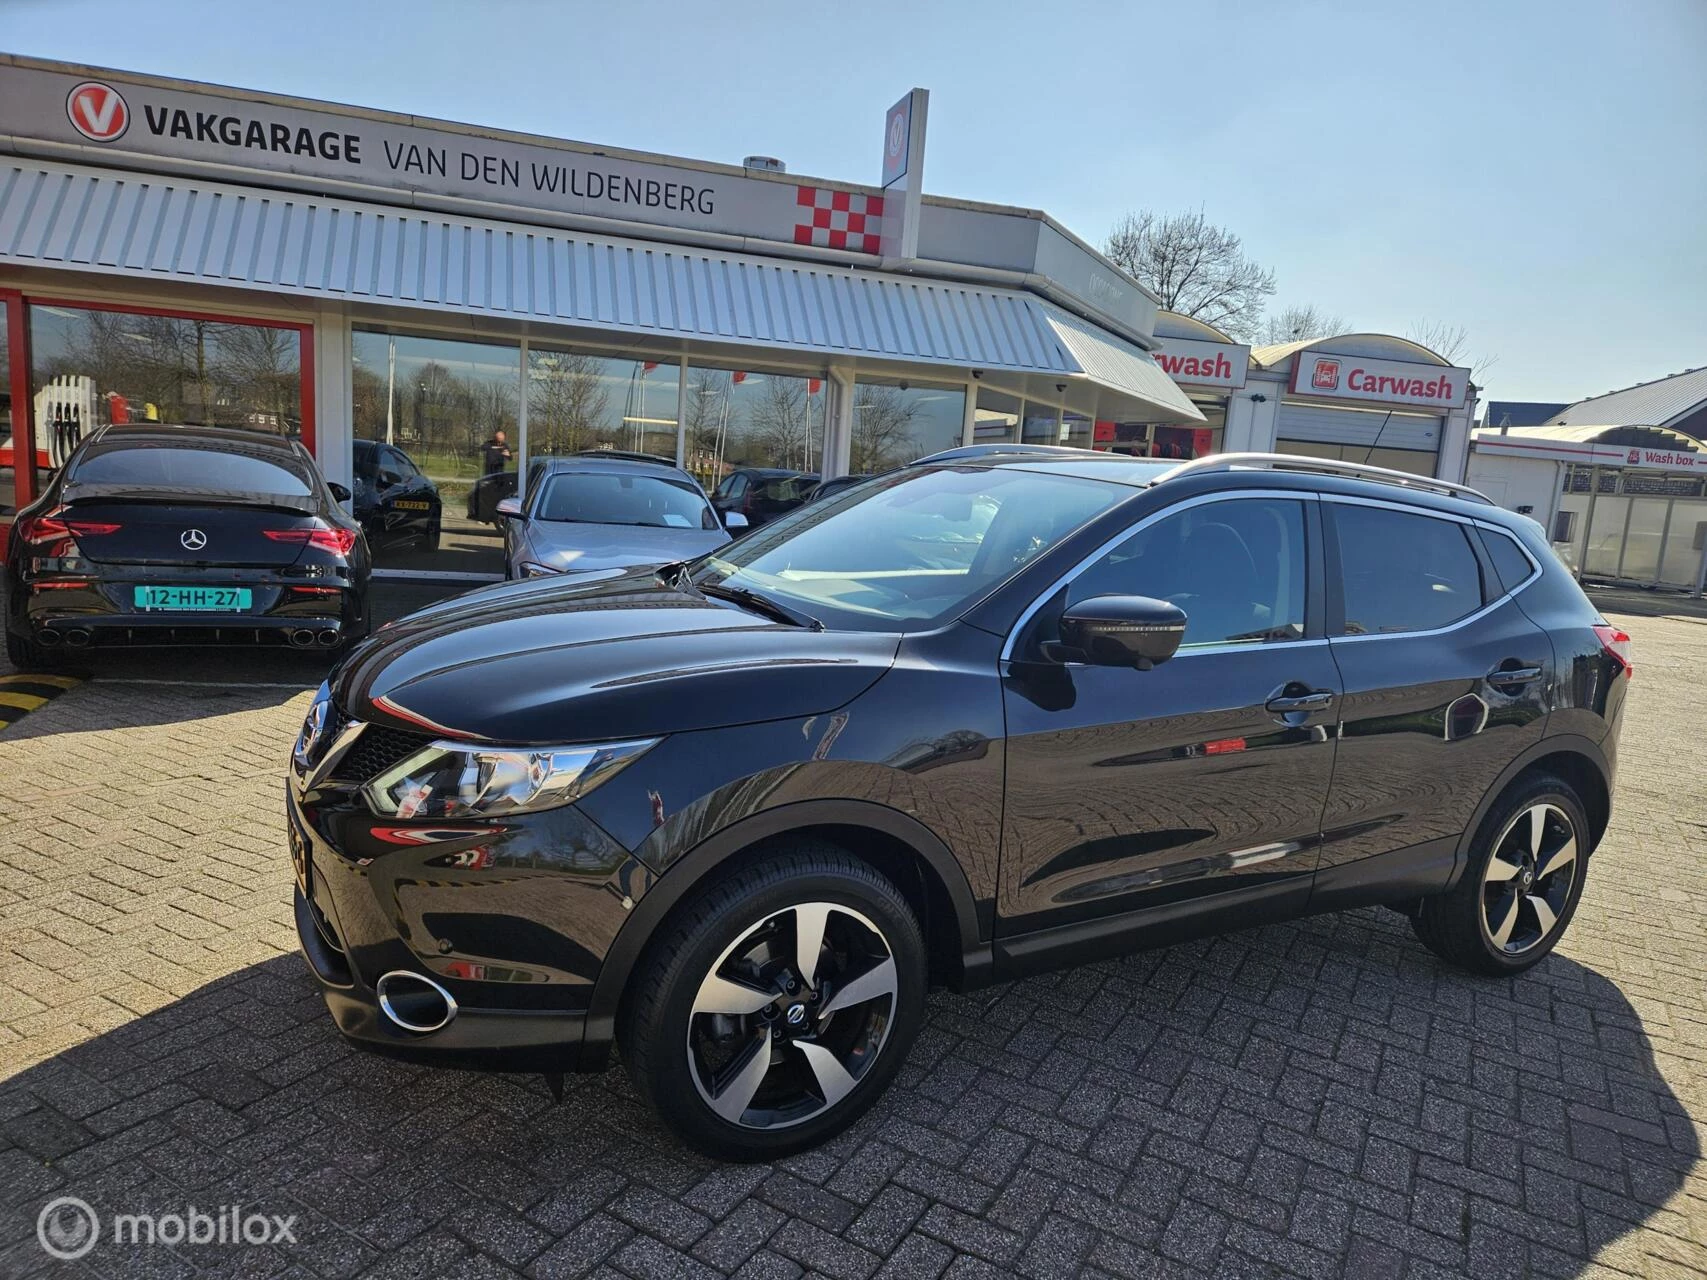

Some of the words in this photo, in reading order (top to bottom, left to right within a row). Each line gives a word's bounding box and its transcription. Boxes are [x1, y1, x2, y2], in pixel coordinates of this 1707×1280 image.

[143, 104, 361, 164] VAKGARAGE
[383, 140, 447, 177] VAN
[460, 152, 520, 188] DEN
[531, 162, 715, 215] WILDENBERG
[1347, 368, 1453, 400] Carwash
[1645, 451, 1674, 465] Wash
[1676, 453, 1695, 466] box
[149, 589, 238, 606] 12-HH-27
